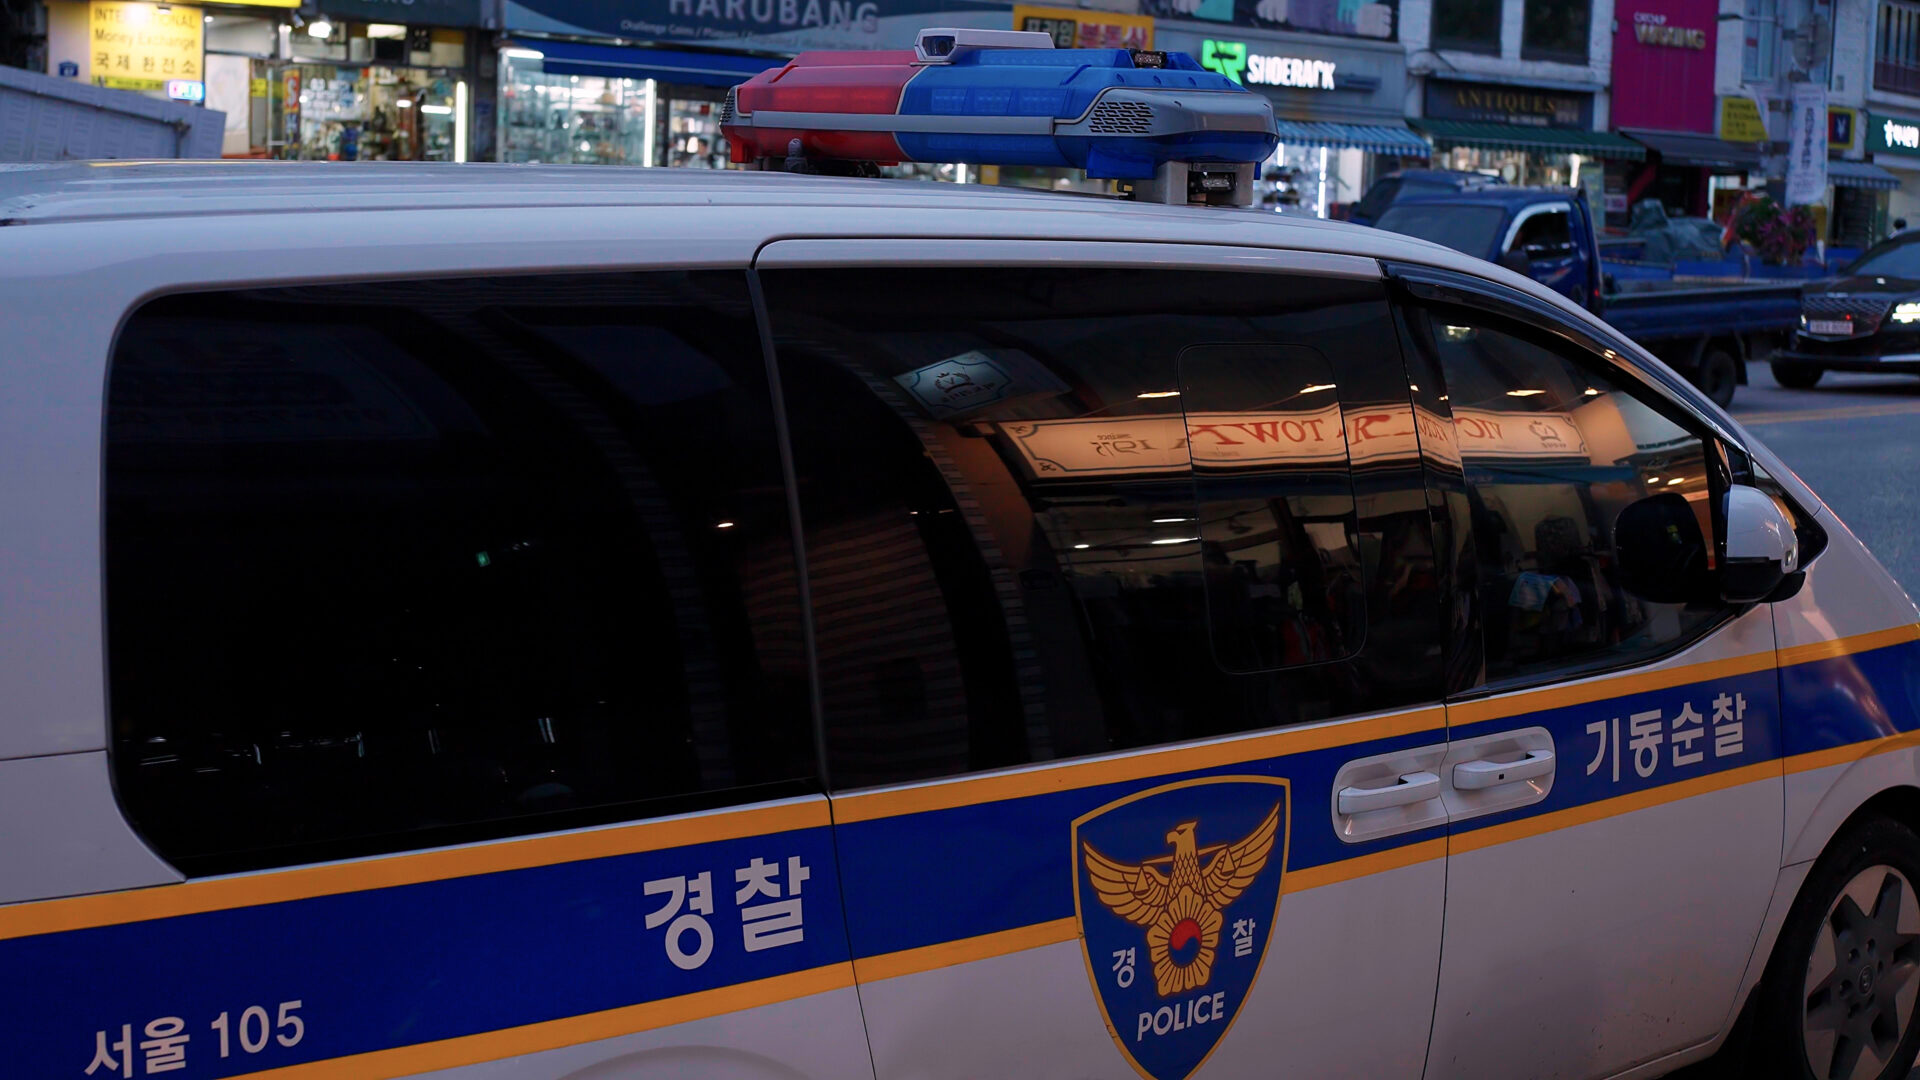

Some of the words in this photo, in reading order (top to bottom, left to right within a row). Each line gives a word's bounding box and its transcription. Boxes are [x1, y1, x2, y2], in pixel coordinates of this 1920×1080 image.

[95, 28, 133, 48] Money
[137, 32, 196, 51] Exchange
[1455, 89, 1556, 113] ANTIQUES
[1586, 692, 1747, 782] 기동순찰
[643, 855, 811, 971] 경찰
[1112, 946, 1136, 989] 경
[1232, 918, 1256, 958] 찰
[83, 1016, 190, 1079] 서울
[211, 999, 305, 1059] 105
[1136, 991, 1226, 1042] POLICE
